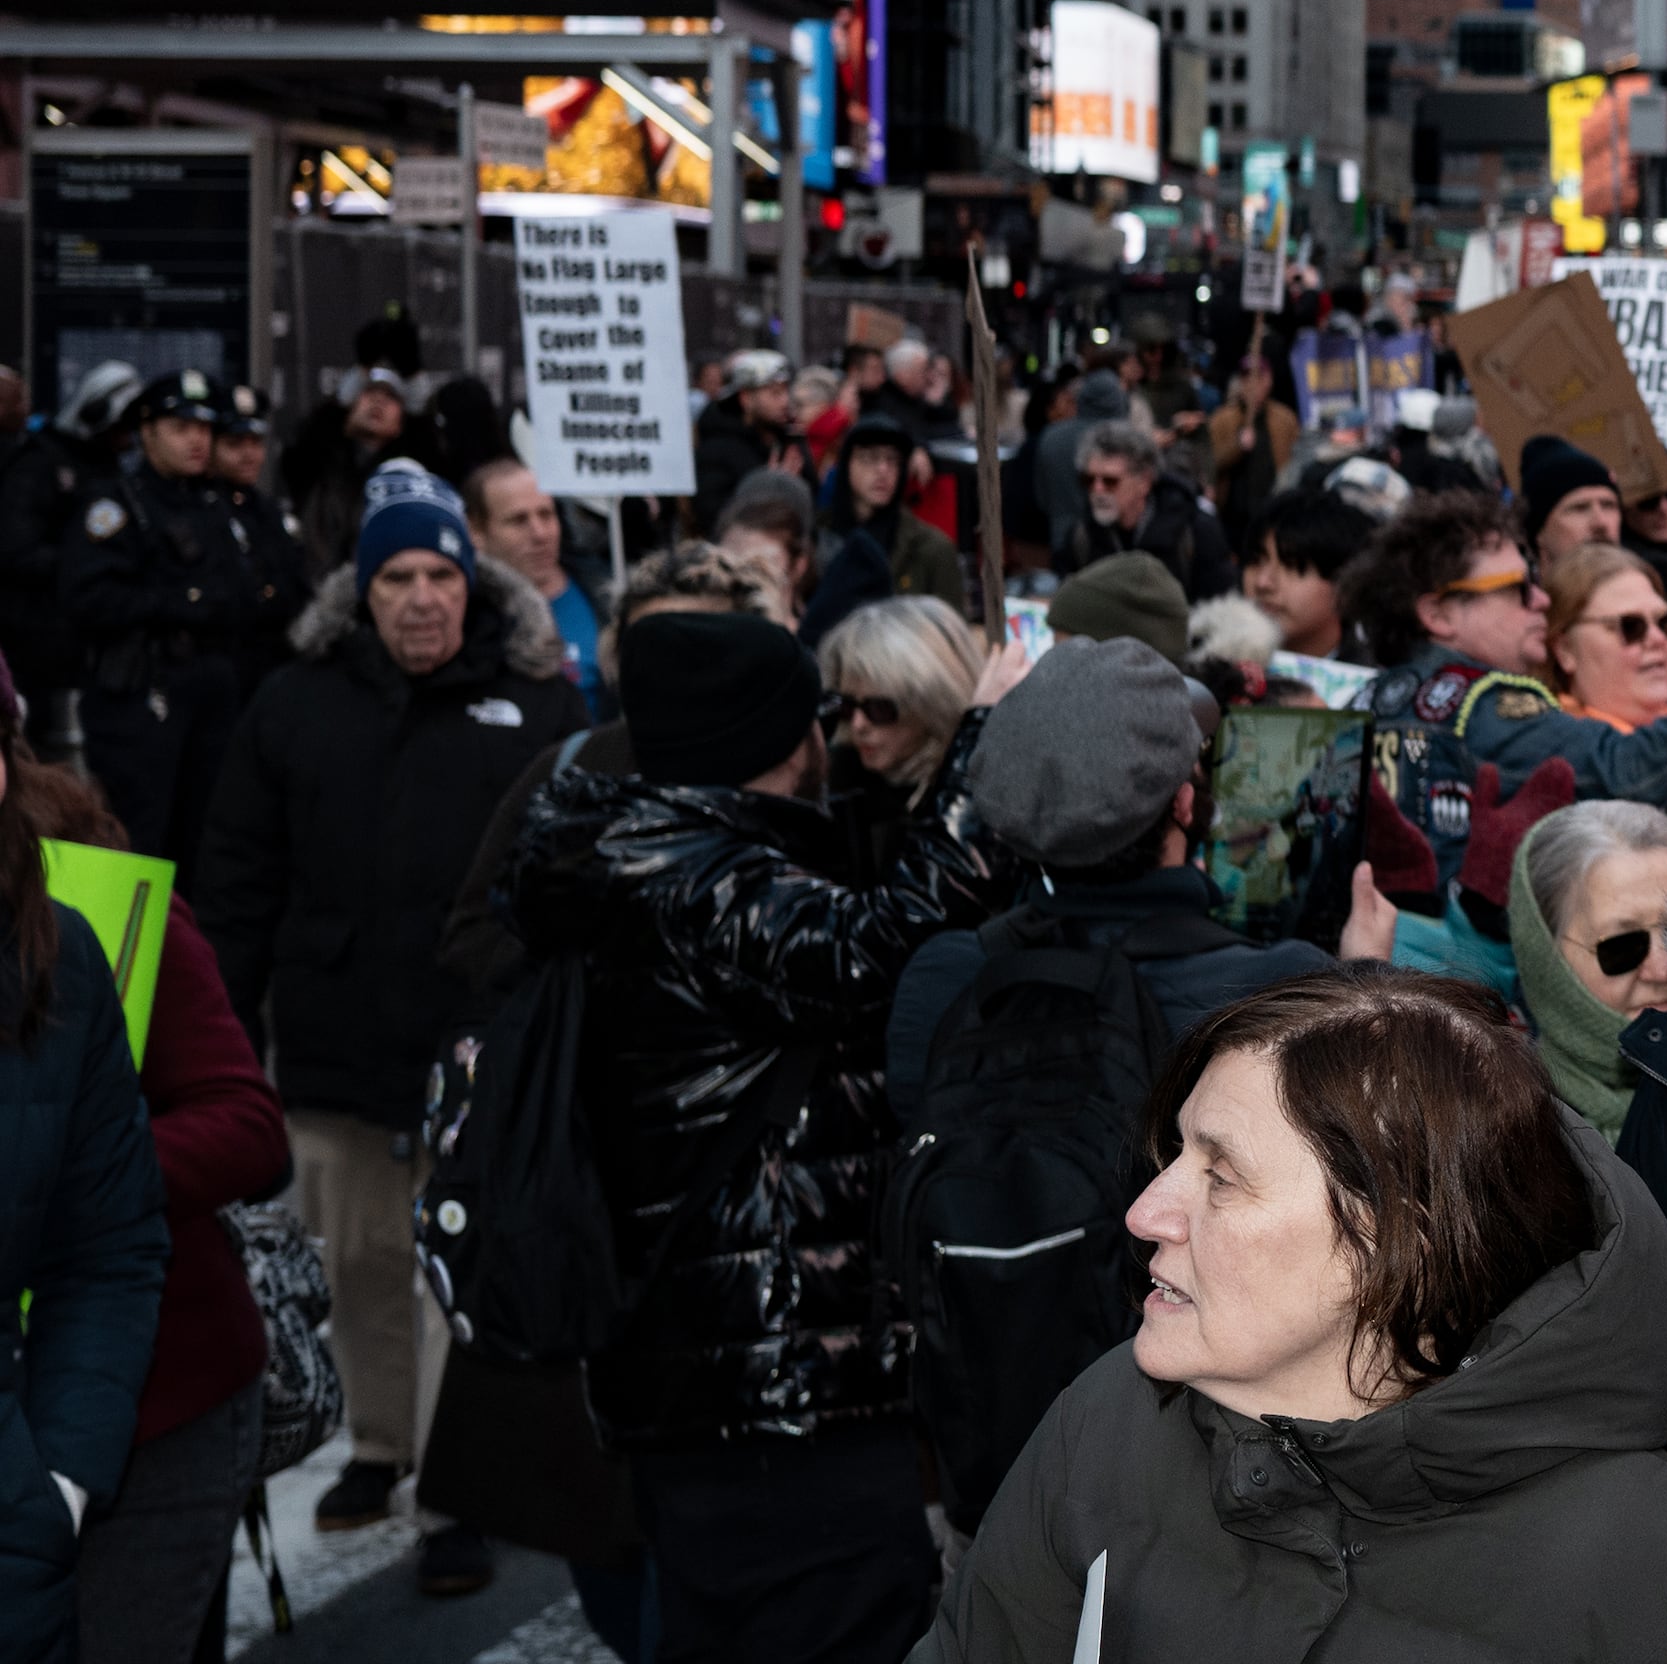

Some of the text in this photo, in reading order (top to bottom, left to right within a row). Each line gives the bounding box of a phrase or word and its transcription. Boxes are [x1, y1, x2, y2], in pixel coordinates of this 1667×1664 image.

[523, 223, 582, 248] There
[552, 259, 596, 282] Flag
[604, 259, 668, 285] Large
[1601, 267, 1649, 289] WAR
[525, 292, 641, 317] Enough to
[538, 325, 645, 350] Cover the
[537, 358, 646, 384] Shame of
[570, 392, 641, 416] Killing
[561, 419, 661, 445] Innocent
[575, 450, 652, 475] People
